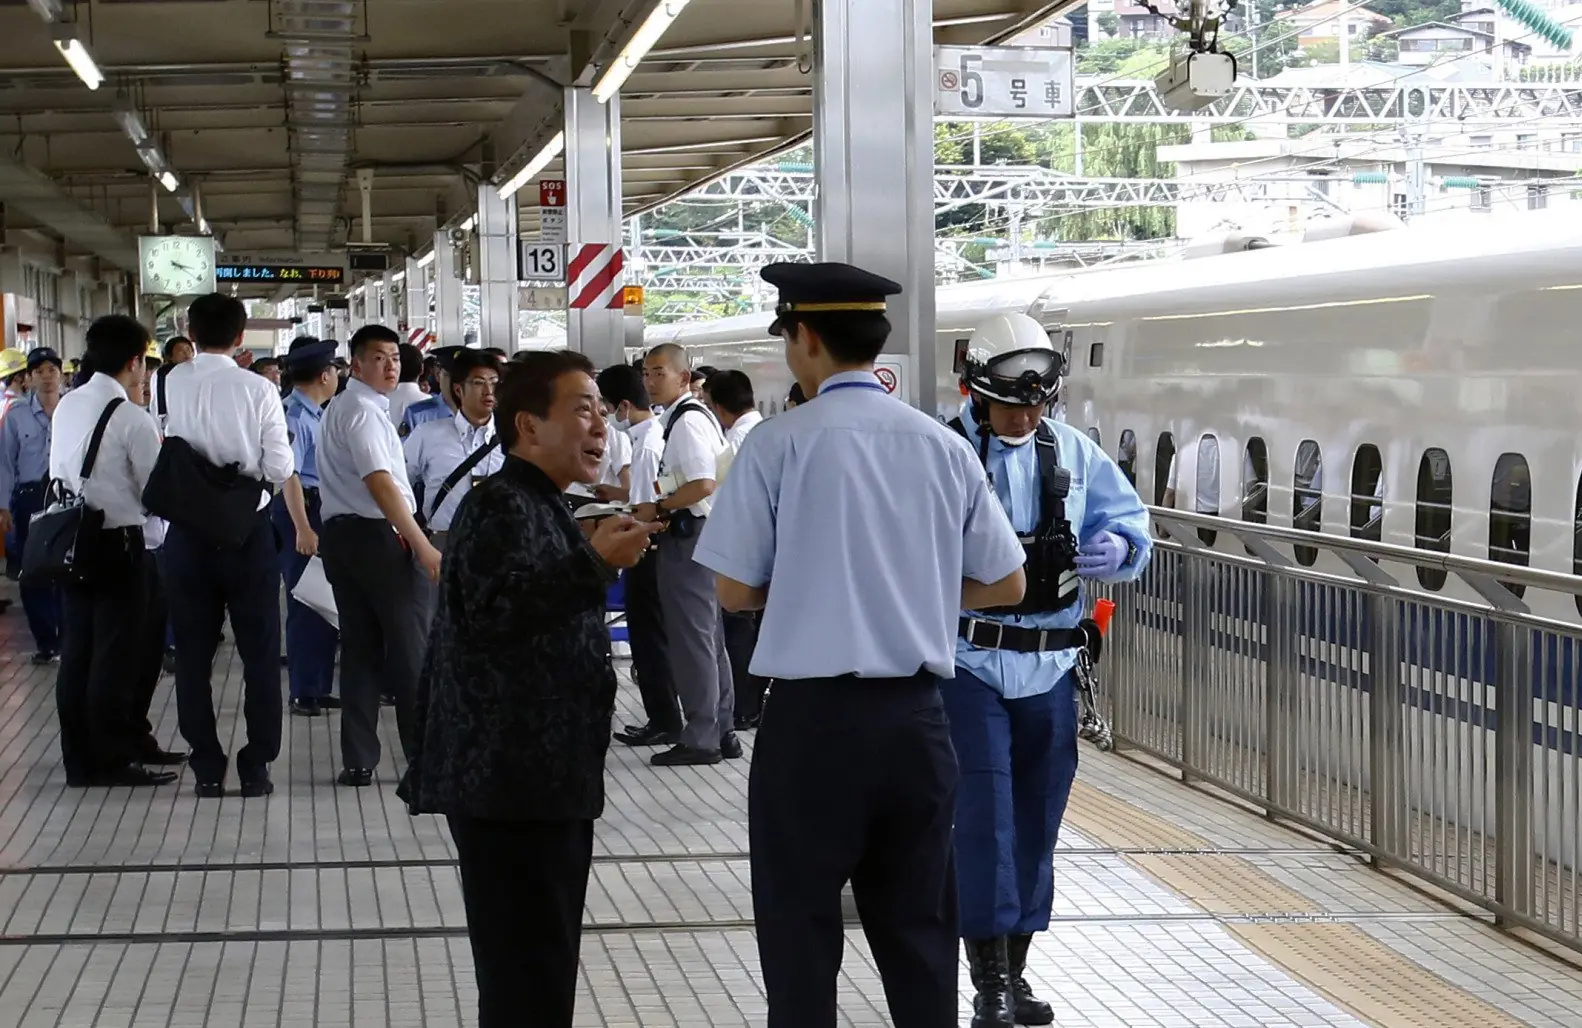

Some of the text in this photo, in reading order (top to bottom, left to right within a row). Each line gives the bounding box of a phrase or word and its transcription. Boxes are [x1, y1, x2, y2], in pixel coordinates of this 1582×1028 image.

[960, 54, 1061, 109] 5号車
[542, 182, 561, 190] SOS
[529, 248, 556, 273] 13
